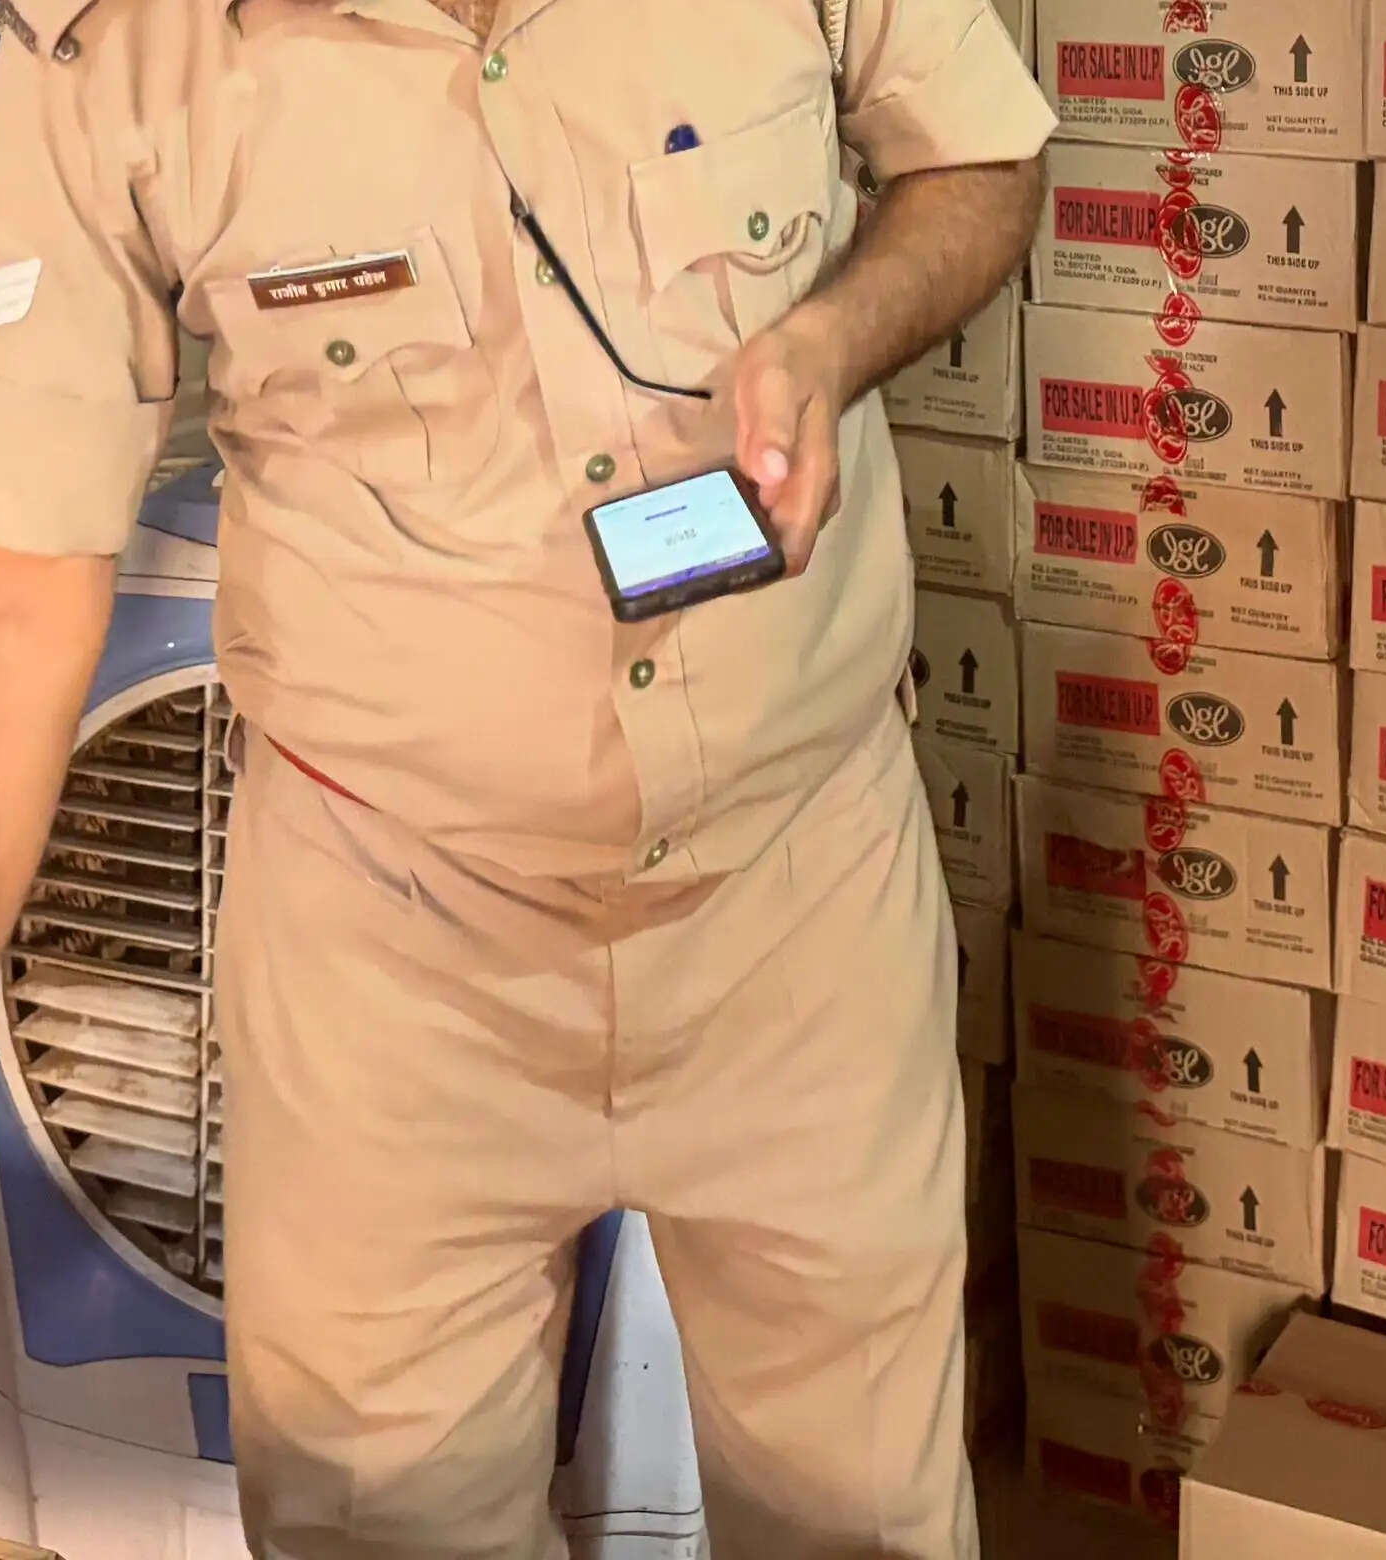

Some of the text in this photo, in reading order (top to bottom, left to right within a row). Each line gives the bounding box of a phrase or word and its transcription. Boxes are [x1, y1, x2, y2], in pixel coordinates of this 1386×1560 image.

[1062, 45, 1088, 78] FOR
[1090, 46, 1121, 81] SALE
[1124, 48, 1137, 80] IN
[1273, 86, 1328, 97] THIS SIDE UP
[1058, 200, 1084, 233] FOR
[1087, 203, 1118, 237] SALE
[1121, 206, 1134, 239] IN
[1044, 384, 1069, 417] FOR
[1072, 387, 1103, 421] SALE
[1105, 390, 1117, 424] IN
[1039, 513, 1064, 550] FOR
[1066, 517, 1096, 555] SALE
[1099, 521, 1111, 557] IN
[1353, 1061, 1381, 1096] FOR
